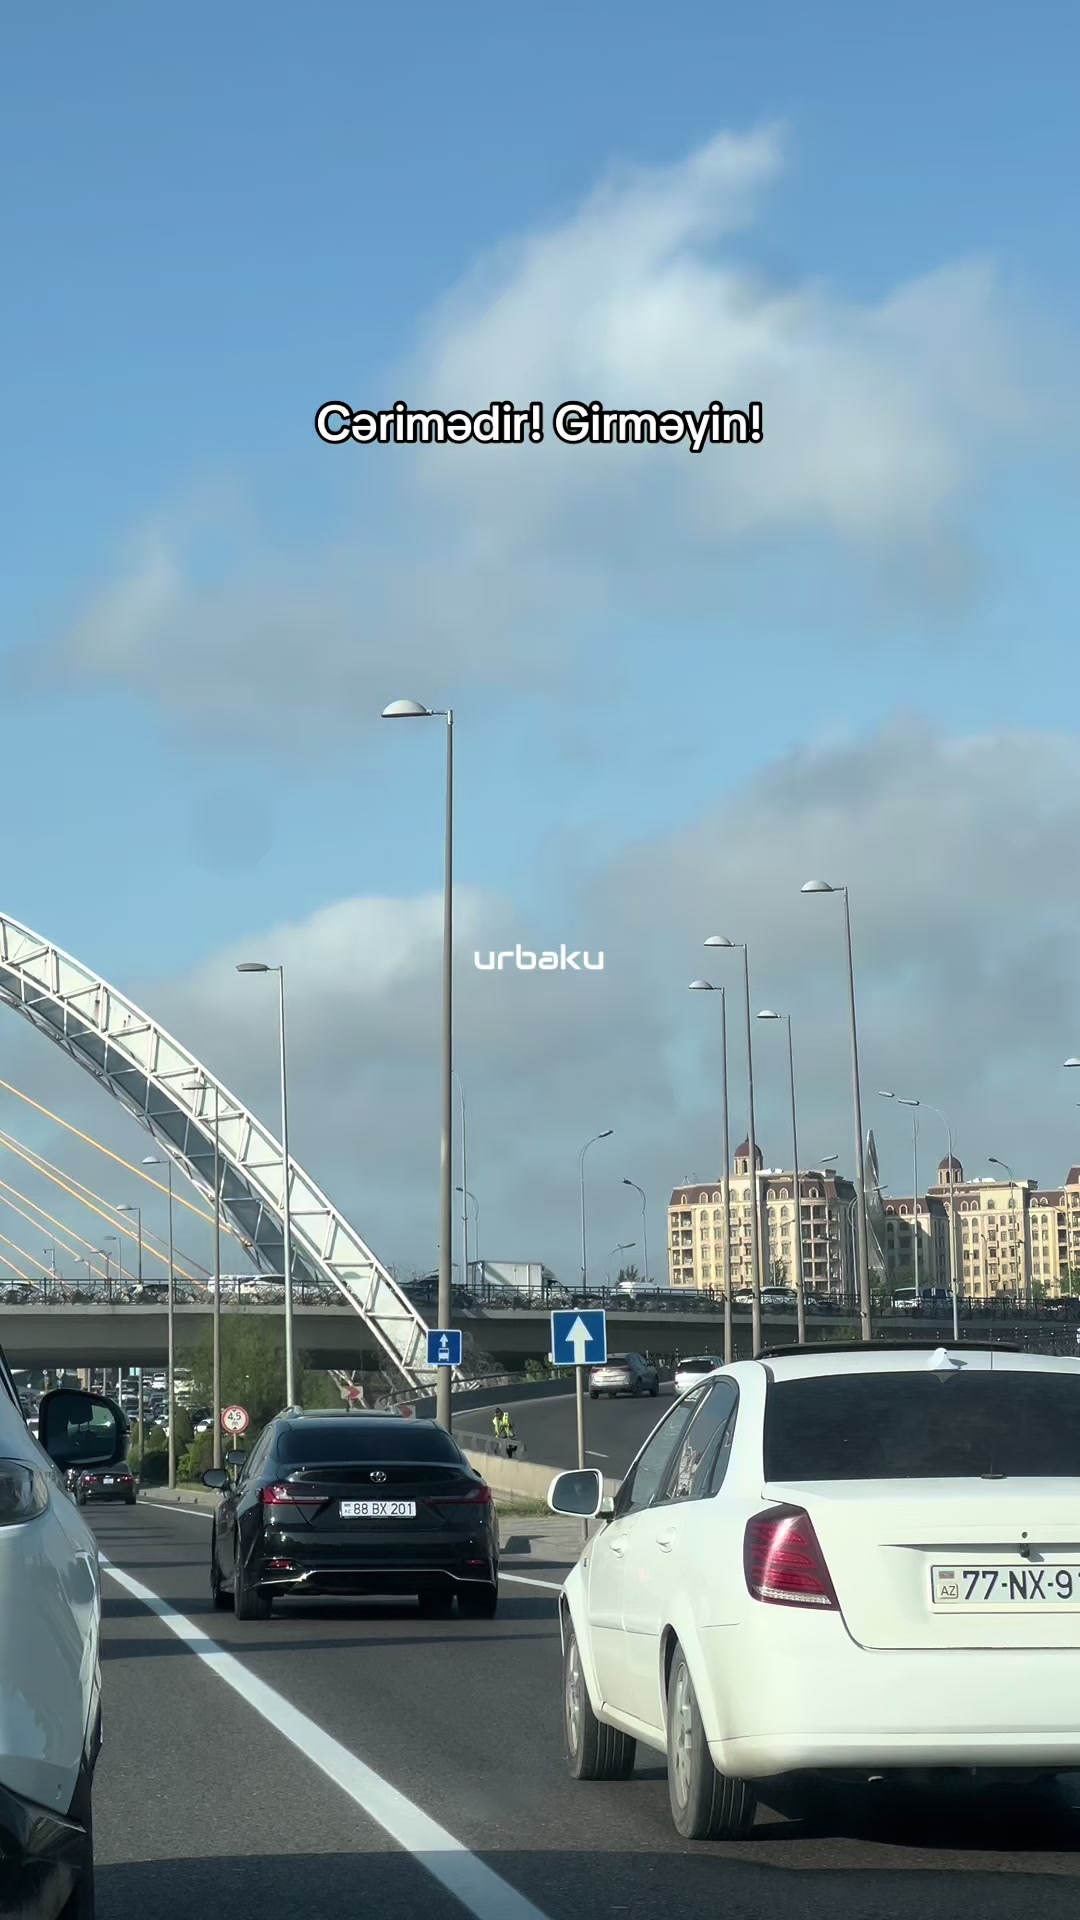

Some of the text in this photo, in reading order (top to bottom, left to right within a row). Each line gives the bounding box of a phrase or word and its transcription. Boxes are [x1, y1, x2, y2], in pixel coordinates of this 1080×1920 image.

[353, 1503, 412, 1514] 88 BX 201
[962, 1569, 1080, 1600] 77-NX-9
[940, 1585, 957, 1596] AZ
